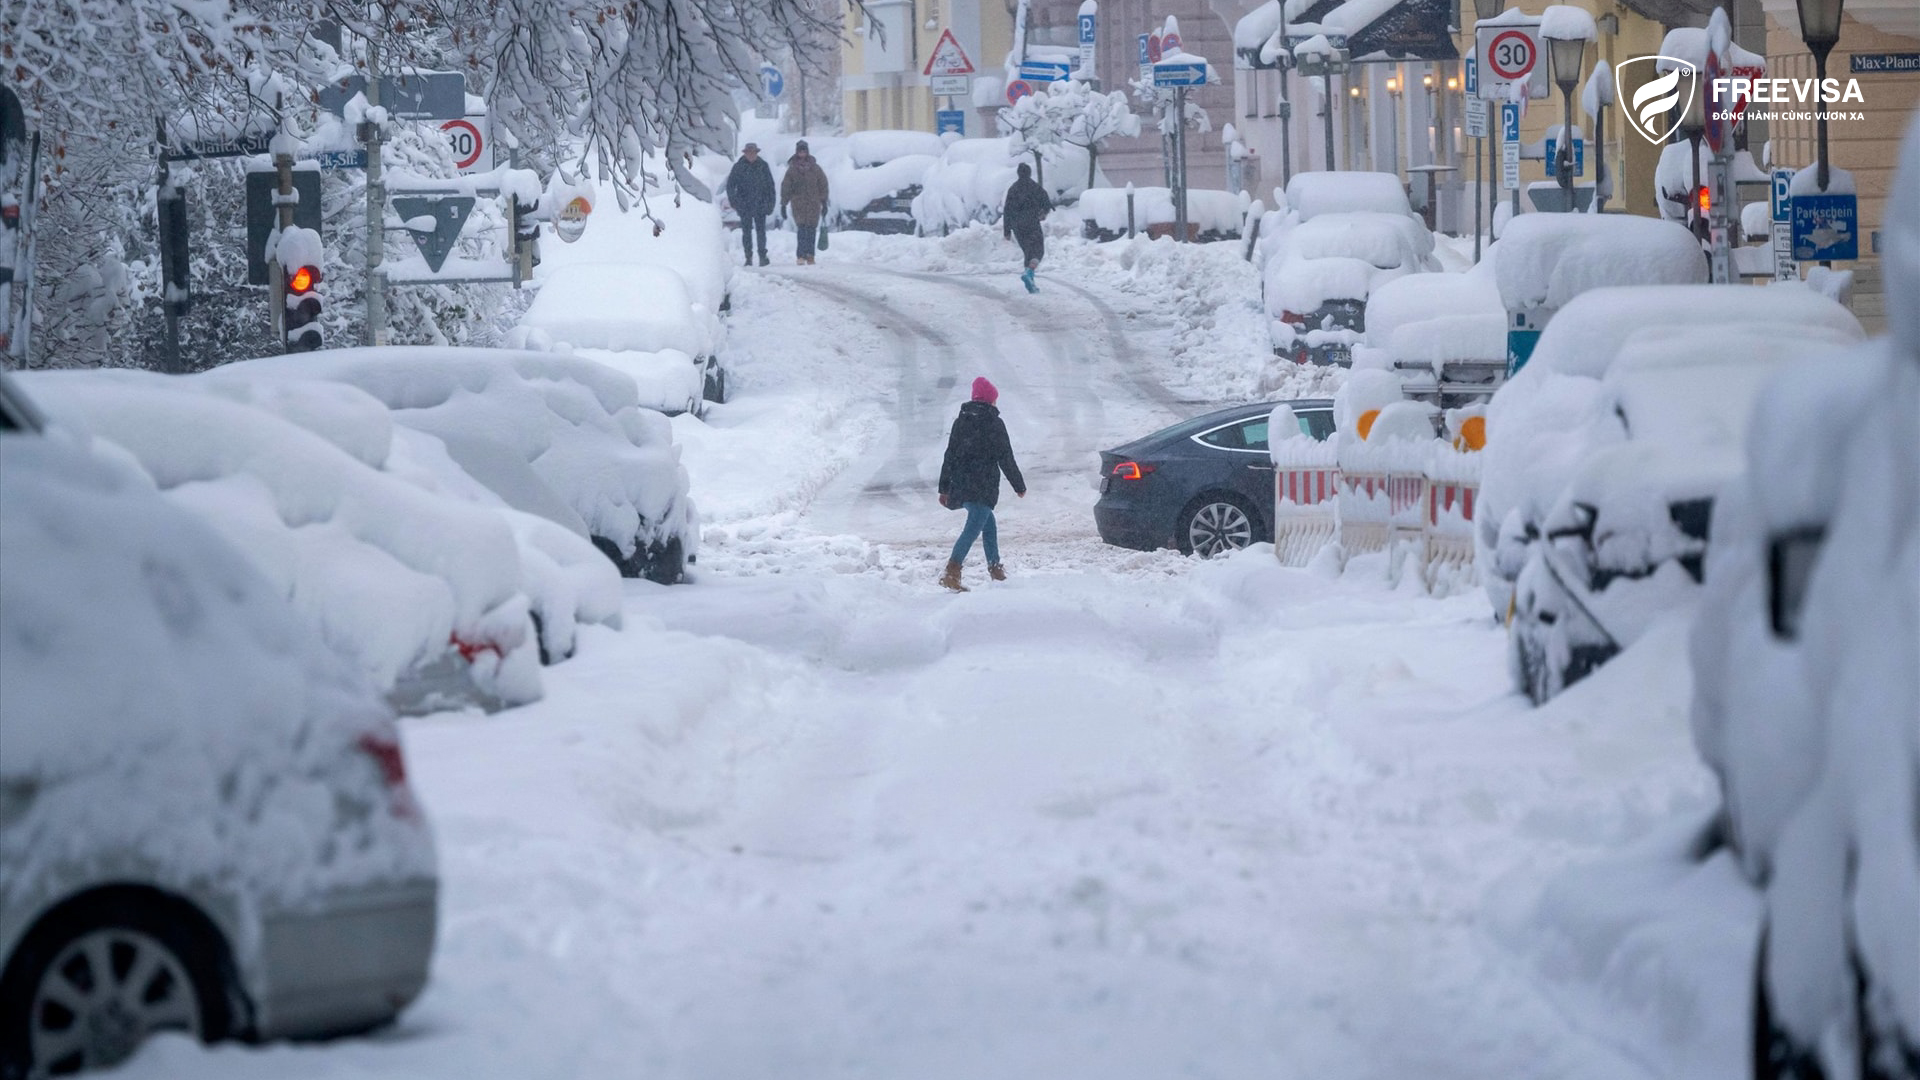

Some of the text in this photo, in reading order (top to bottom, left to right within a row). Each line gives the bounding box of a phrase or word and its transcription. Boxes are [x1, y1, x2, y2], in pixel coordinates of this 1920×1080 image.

[1082, 18, 1092, 40] P
[1498, 44, 1526, 66] 30
[1504, 109, 1515, 138] P
[1775, 178, 1789, 215] P
[1796, 205, 1853, 219] Parkschein
